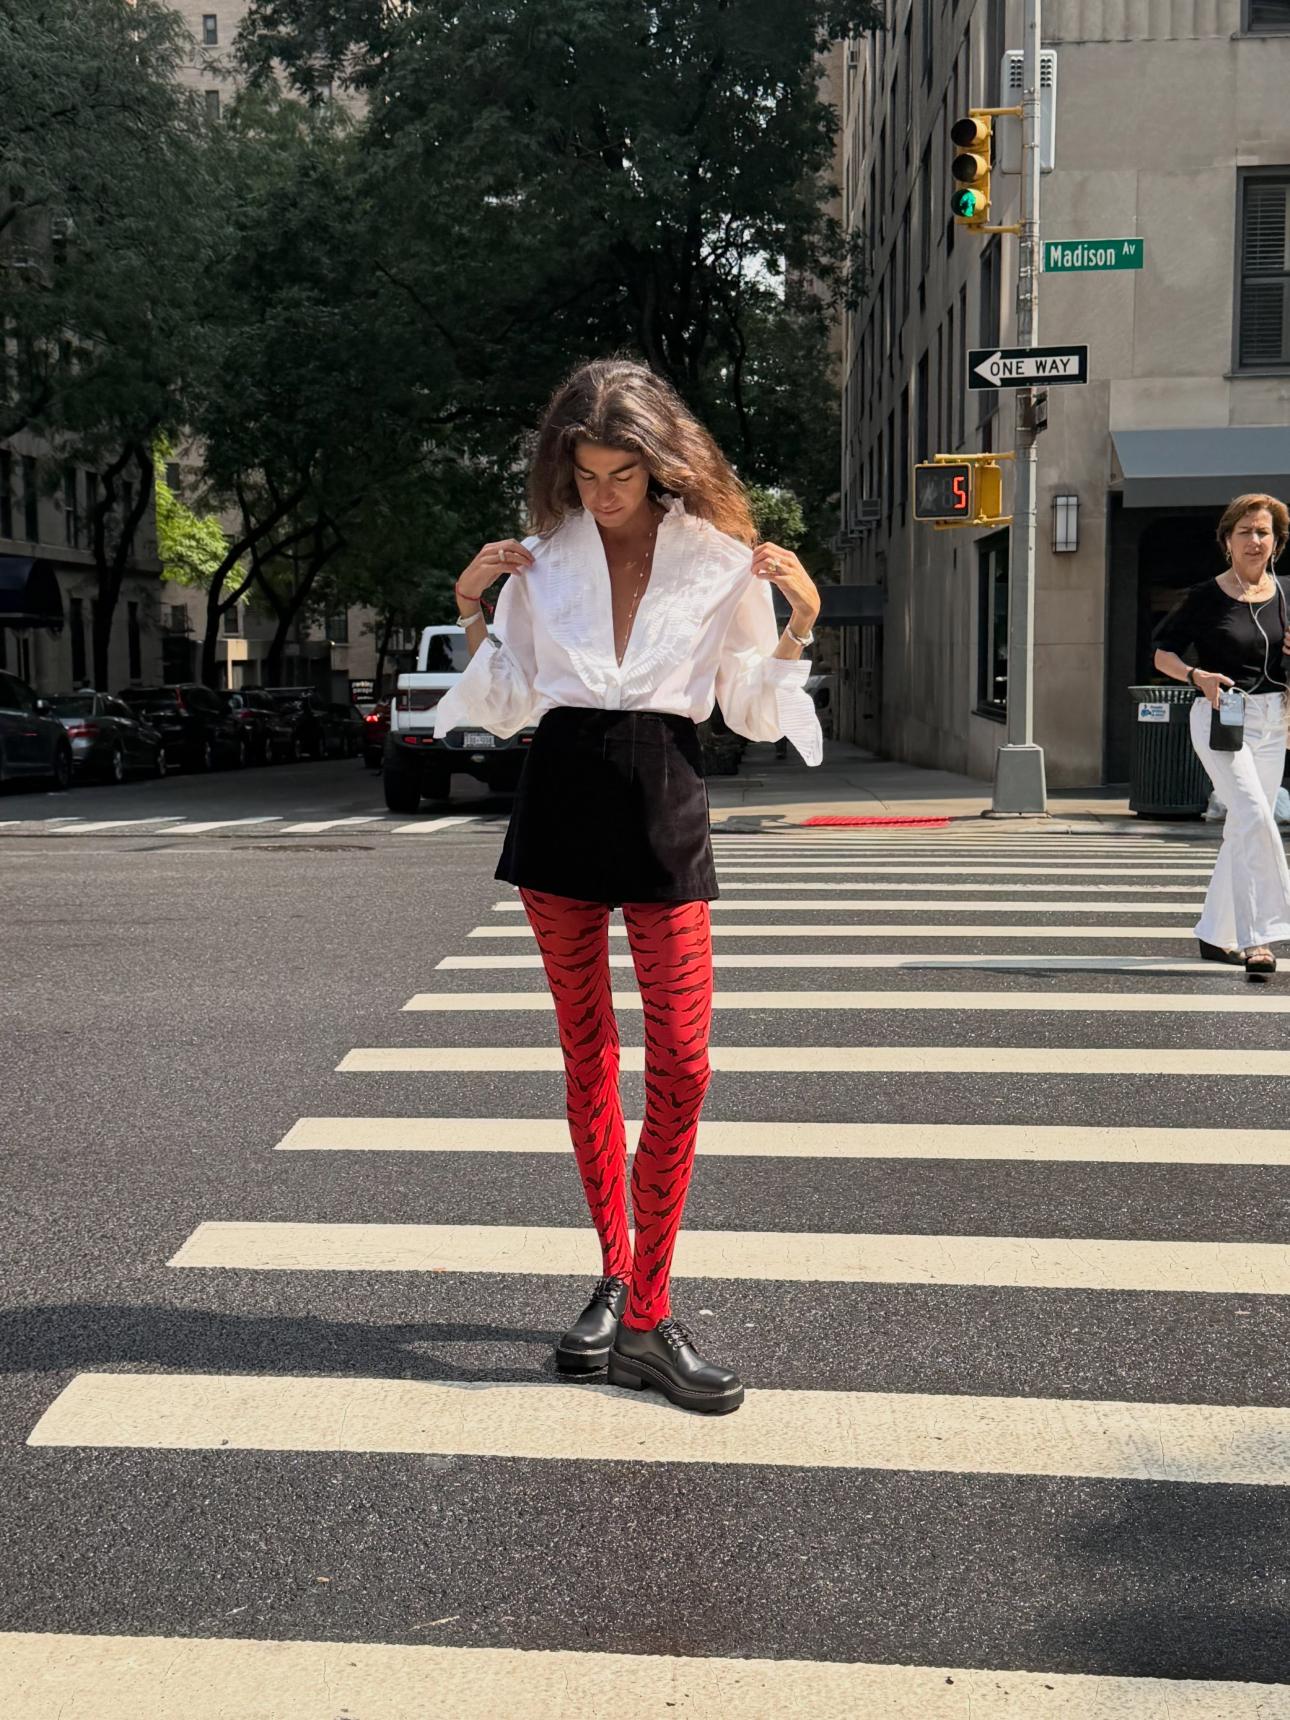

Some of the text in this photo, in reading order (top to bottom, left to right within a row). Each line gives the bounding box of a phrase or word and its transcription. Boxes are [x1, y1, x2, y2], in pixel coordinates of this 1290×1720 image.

[1050, 241, 1136, 268] Madison Av
[990, 358, 1071, 376] ONE WAY
[953, 476, 966, 508] 5
